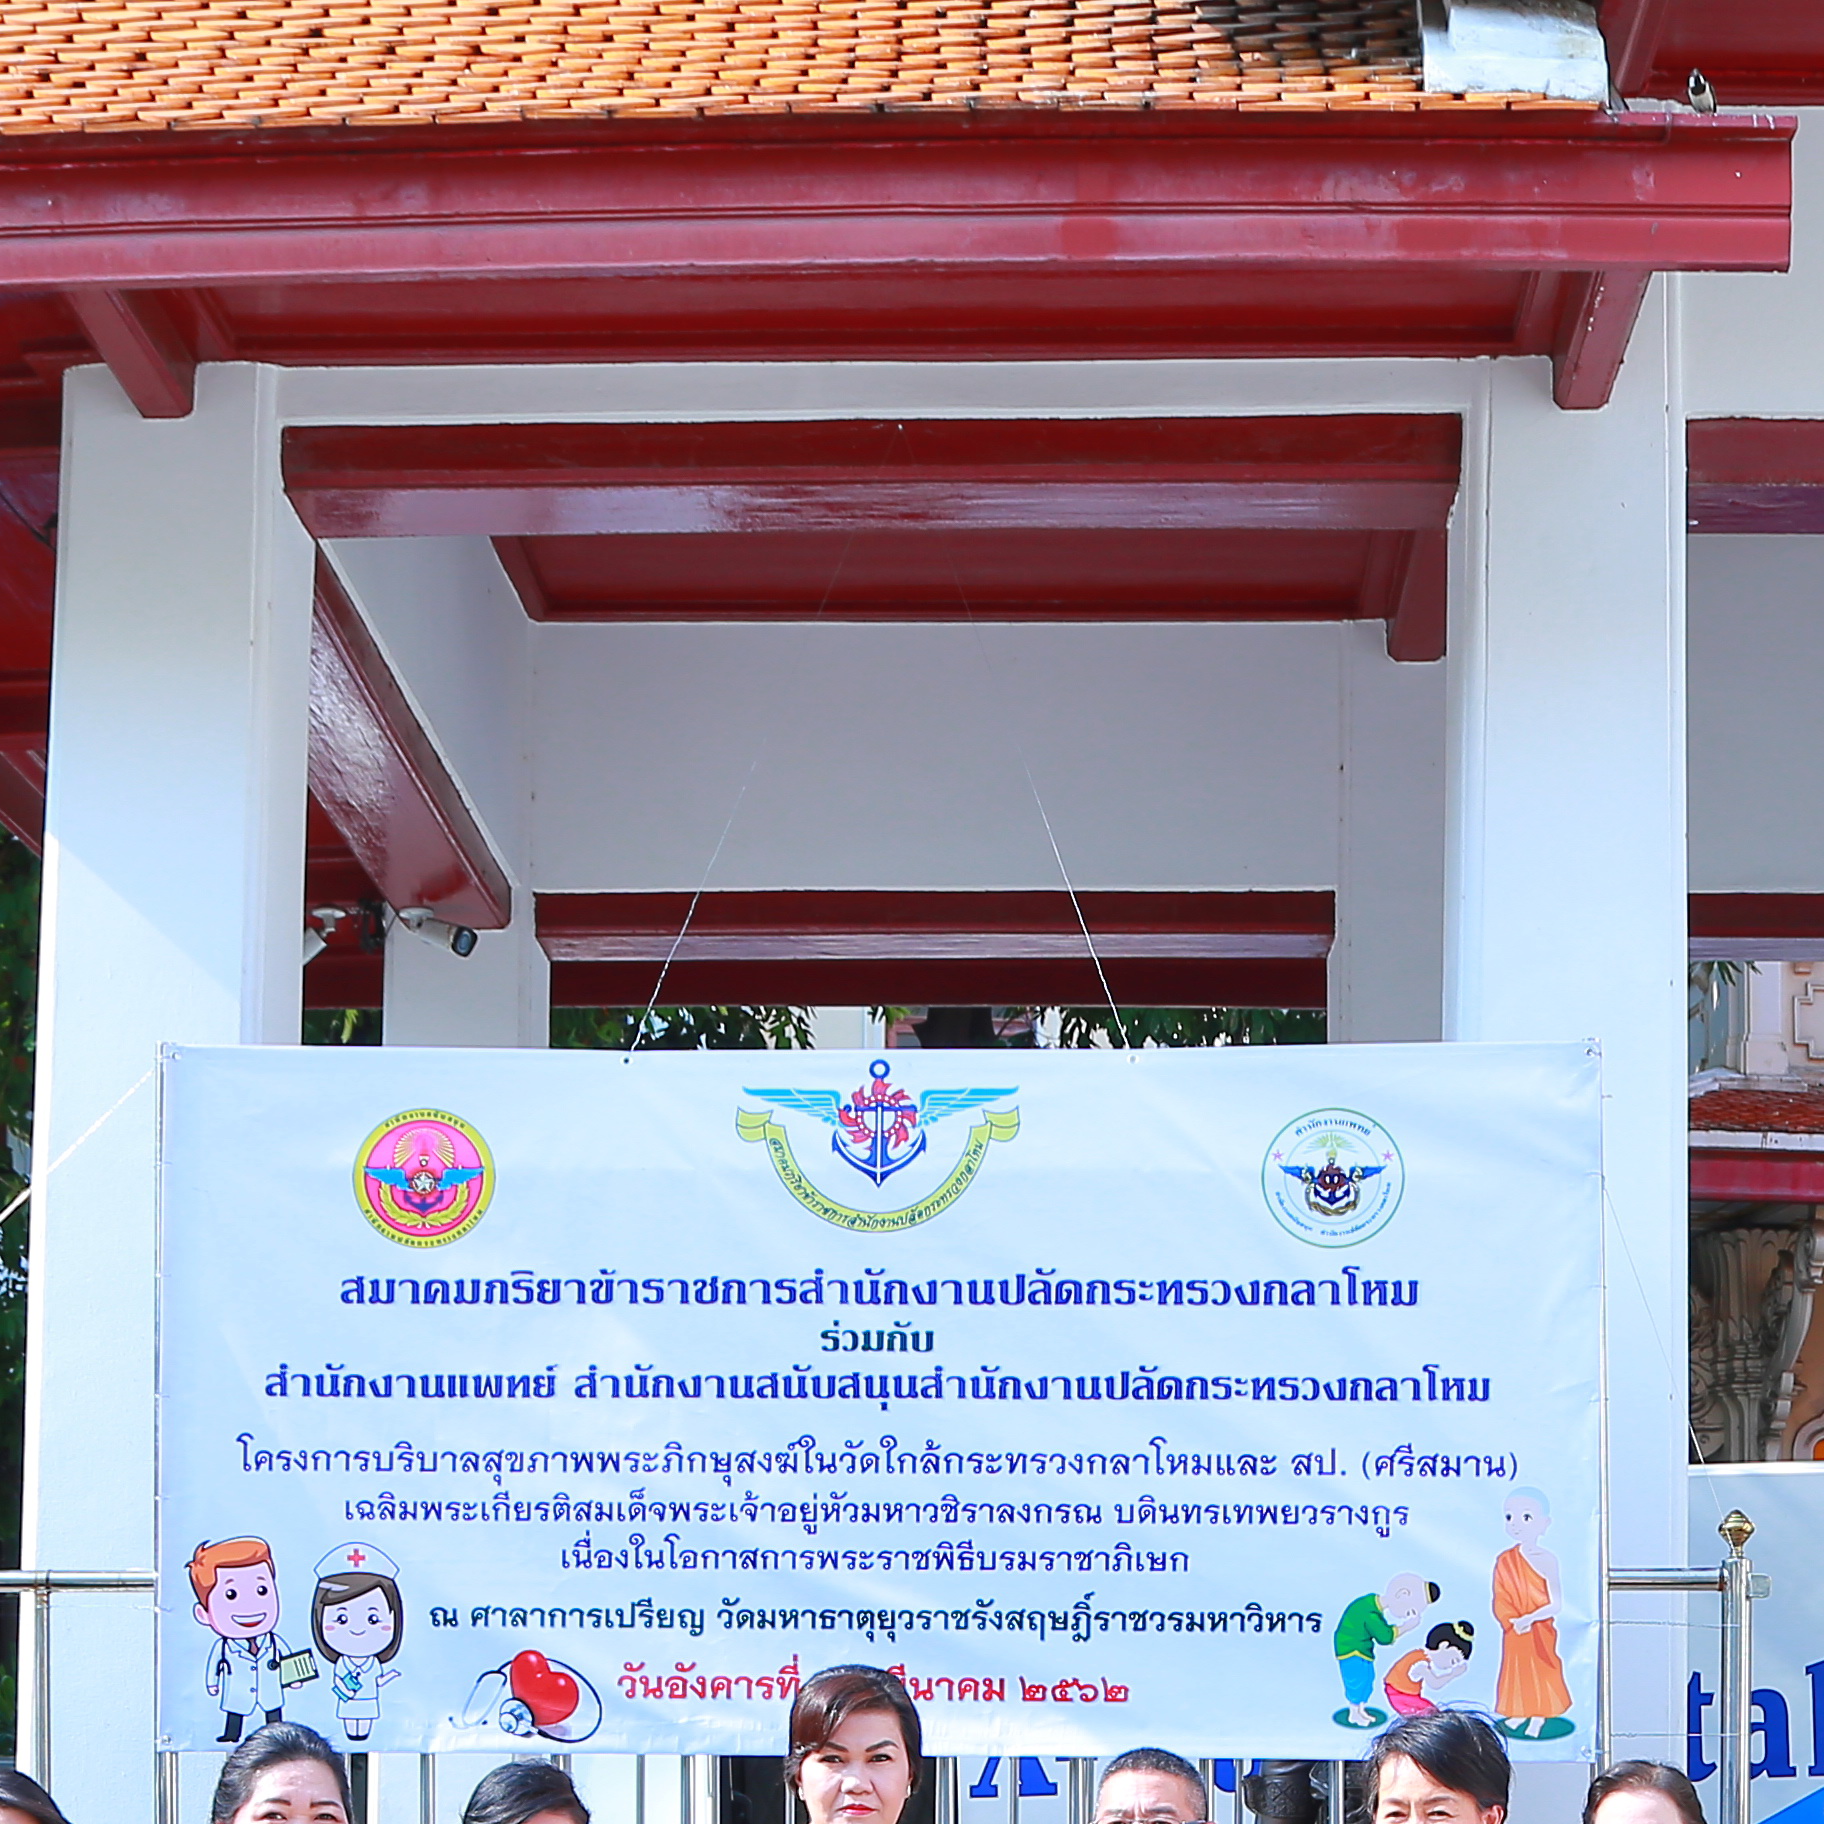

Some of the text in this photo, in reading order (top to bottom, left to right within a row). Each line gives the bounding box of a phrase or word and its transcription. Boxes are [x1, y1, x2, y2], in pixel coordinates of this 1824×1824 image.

[339, 1266, 1420, 1307] สมาคมภริยาข้าราชการสำนักงานปลัดกระทรวงกลาโหม
[820, 1319, 935, 1353] ร่วมกับ
[264, 1362, 1491, 1411] สำนักงานแพทย์ สำนักงานสนับสนุนสำนักงานปลัดกระทรวงกลาโหม
[236, 1432, 1518, 1486] โครงการบริบาลสุขภาพพระภิกษุสงฆ์ในวัดใกล้กระทรวงกลาโหมและ สป. (ศรีสมาน)
[345, 1487, 1409, 1538] เฉลิมพระเกียรติสมเด็จพระเจ้าอยู่หัวมหาวชิราลงกรณ บดินทรเทพยวรางกูร
[561, 1531, 1189, 1573] เนื่องในโอกาสการพระราชพิธีบรมราชาภิเษก
[429, 1591, 1323, 1643] ณ ศาลาการเปรียญ วัดมหาธาตุยุวราชรังสฤษฎิ์ราชวรมหาวิหาร
[617, 1653, 1130, 1703] วันอังคารที่ ีนาคม ๒๕๖๒
